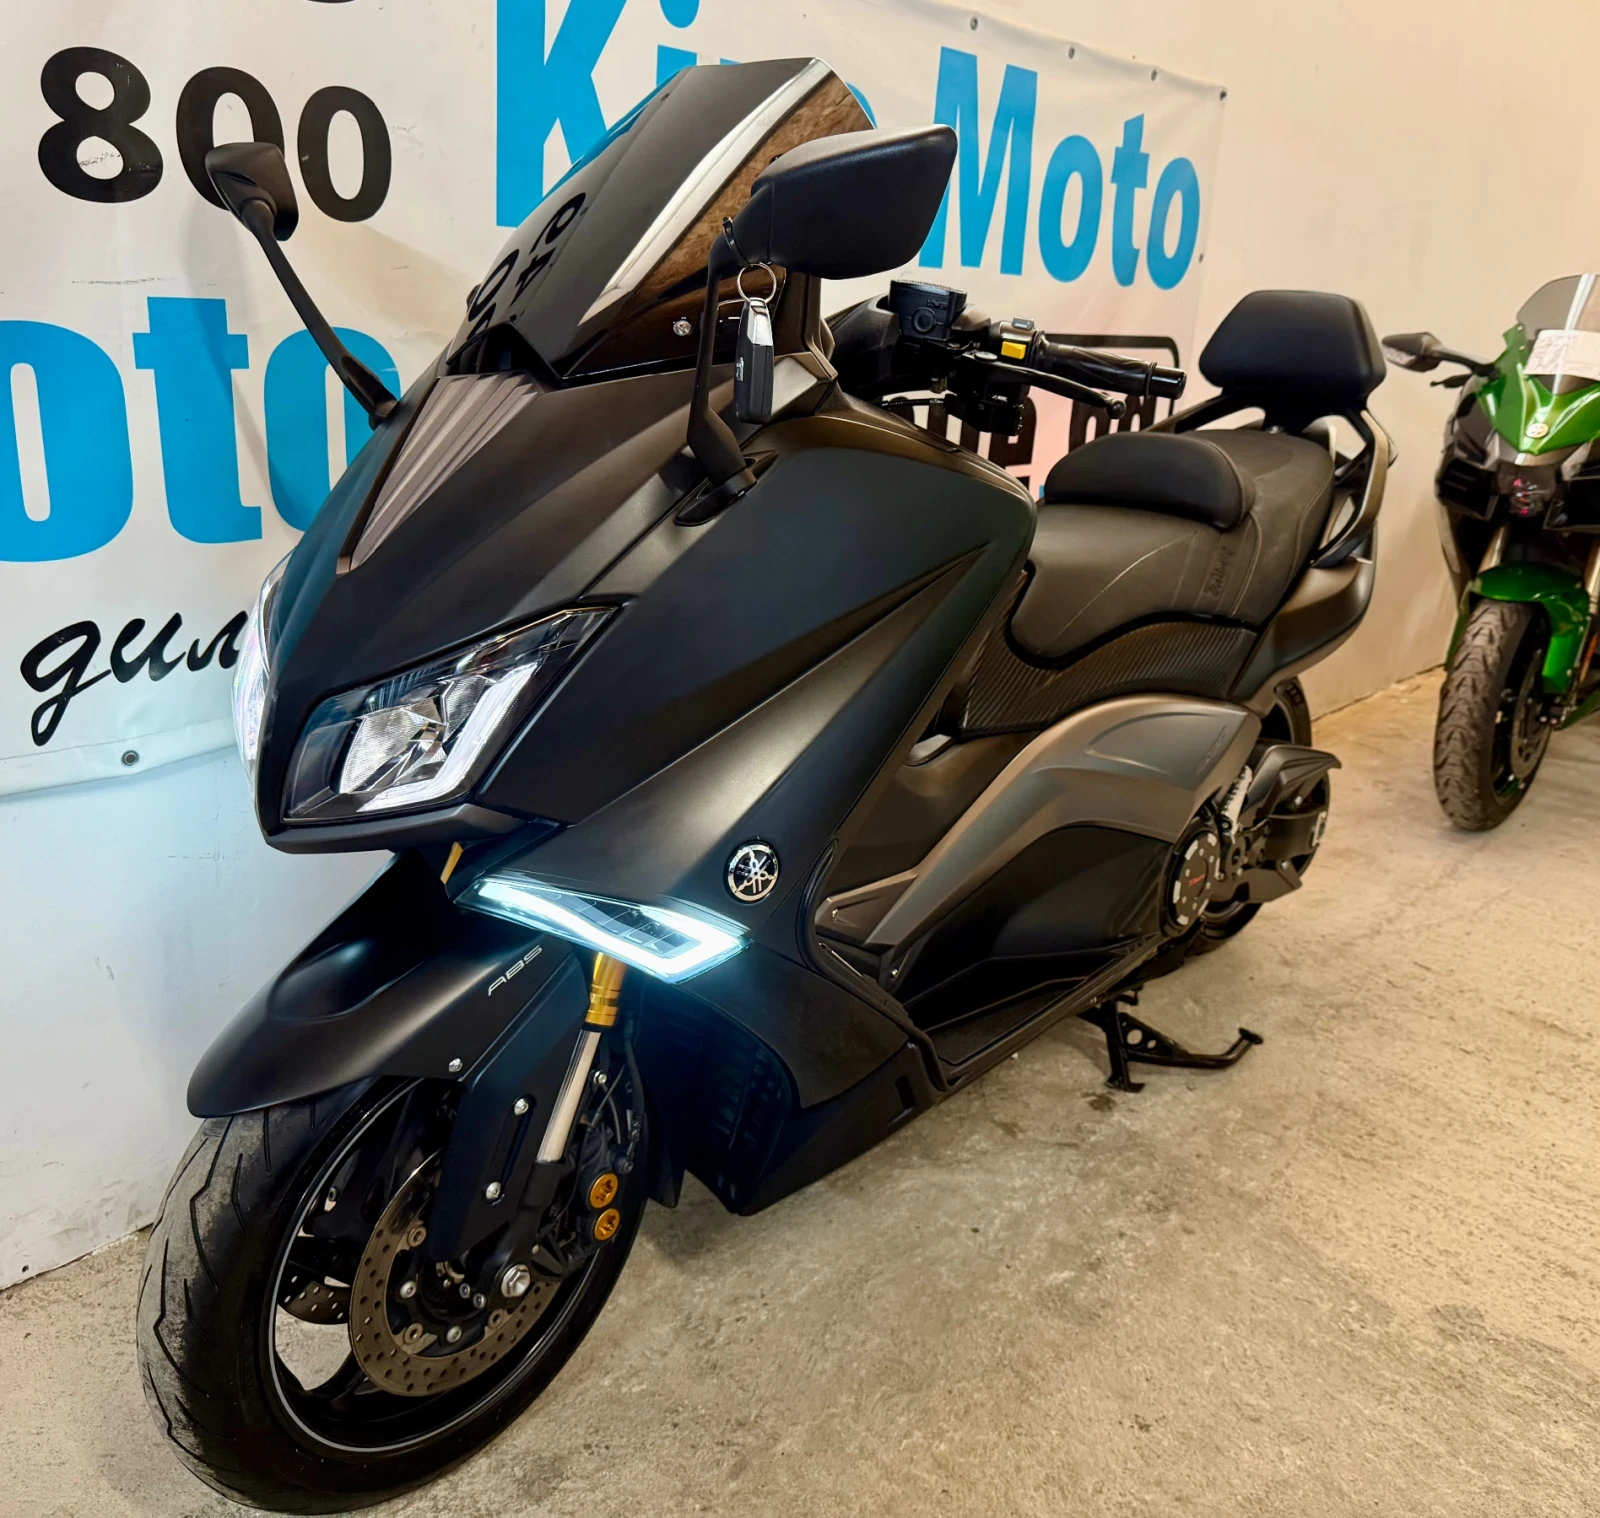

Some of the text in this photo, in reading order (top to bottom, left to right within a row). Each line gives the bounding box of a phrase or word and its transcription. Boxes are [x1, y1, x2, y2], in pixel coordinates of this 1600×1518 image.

[38, 46, 392, 223] 800
[919, 47, 1200, 290] Moto
[487, 944, 543, 997] ABS
